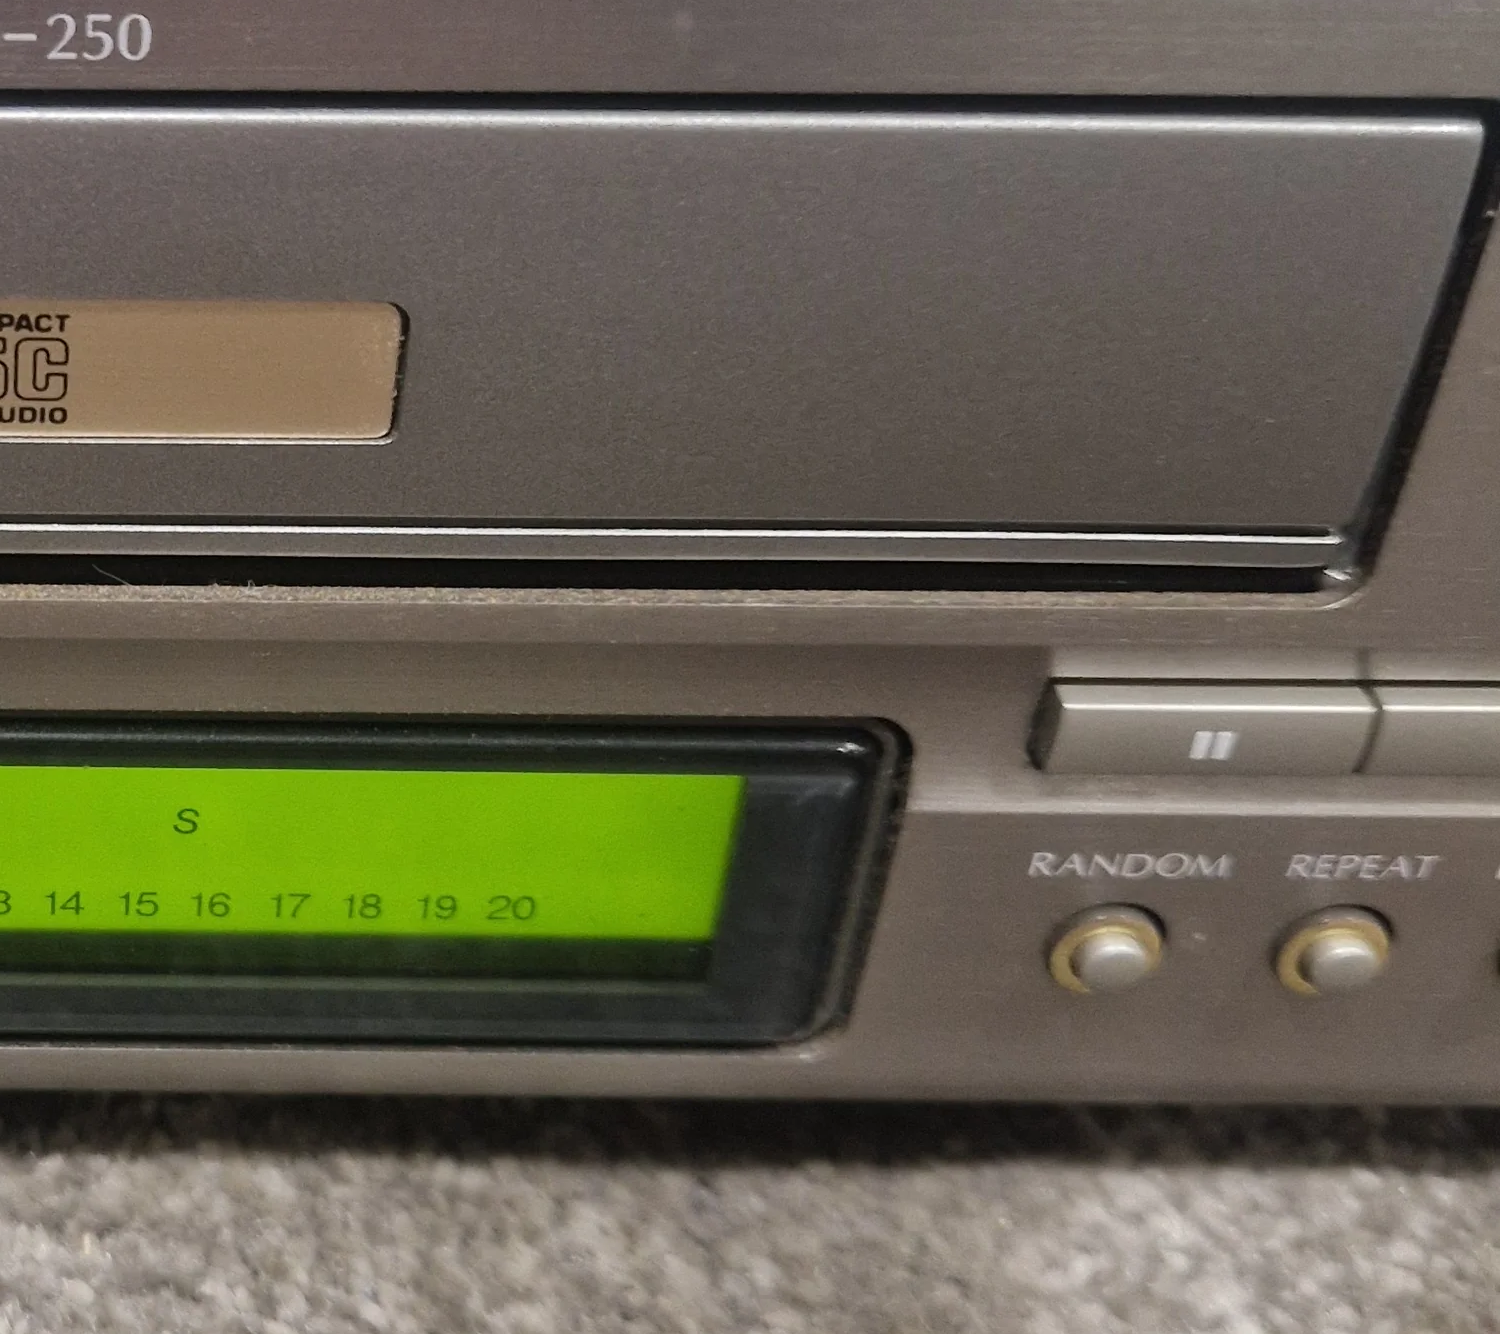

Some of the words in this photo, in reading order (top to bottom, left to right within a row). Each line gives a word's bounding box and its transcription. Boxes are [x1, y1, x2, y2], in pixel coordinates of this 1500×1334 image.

[171, 807, 200, 835] S
[1027, 851, 1235, 881] RANDOM
[1284, 854, 1441, 882] REPEAT
[45, 890, 85, 916] 14
[119, 890, 159, 918] 15
[191, 891, 231, 919] 16
[271, 892, 312, 919] 17
[343, 892, 383, 920] 18
[417, 894, 458, 921] 19
[486, 894, 537, 922] 20
